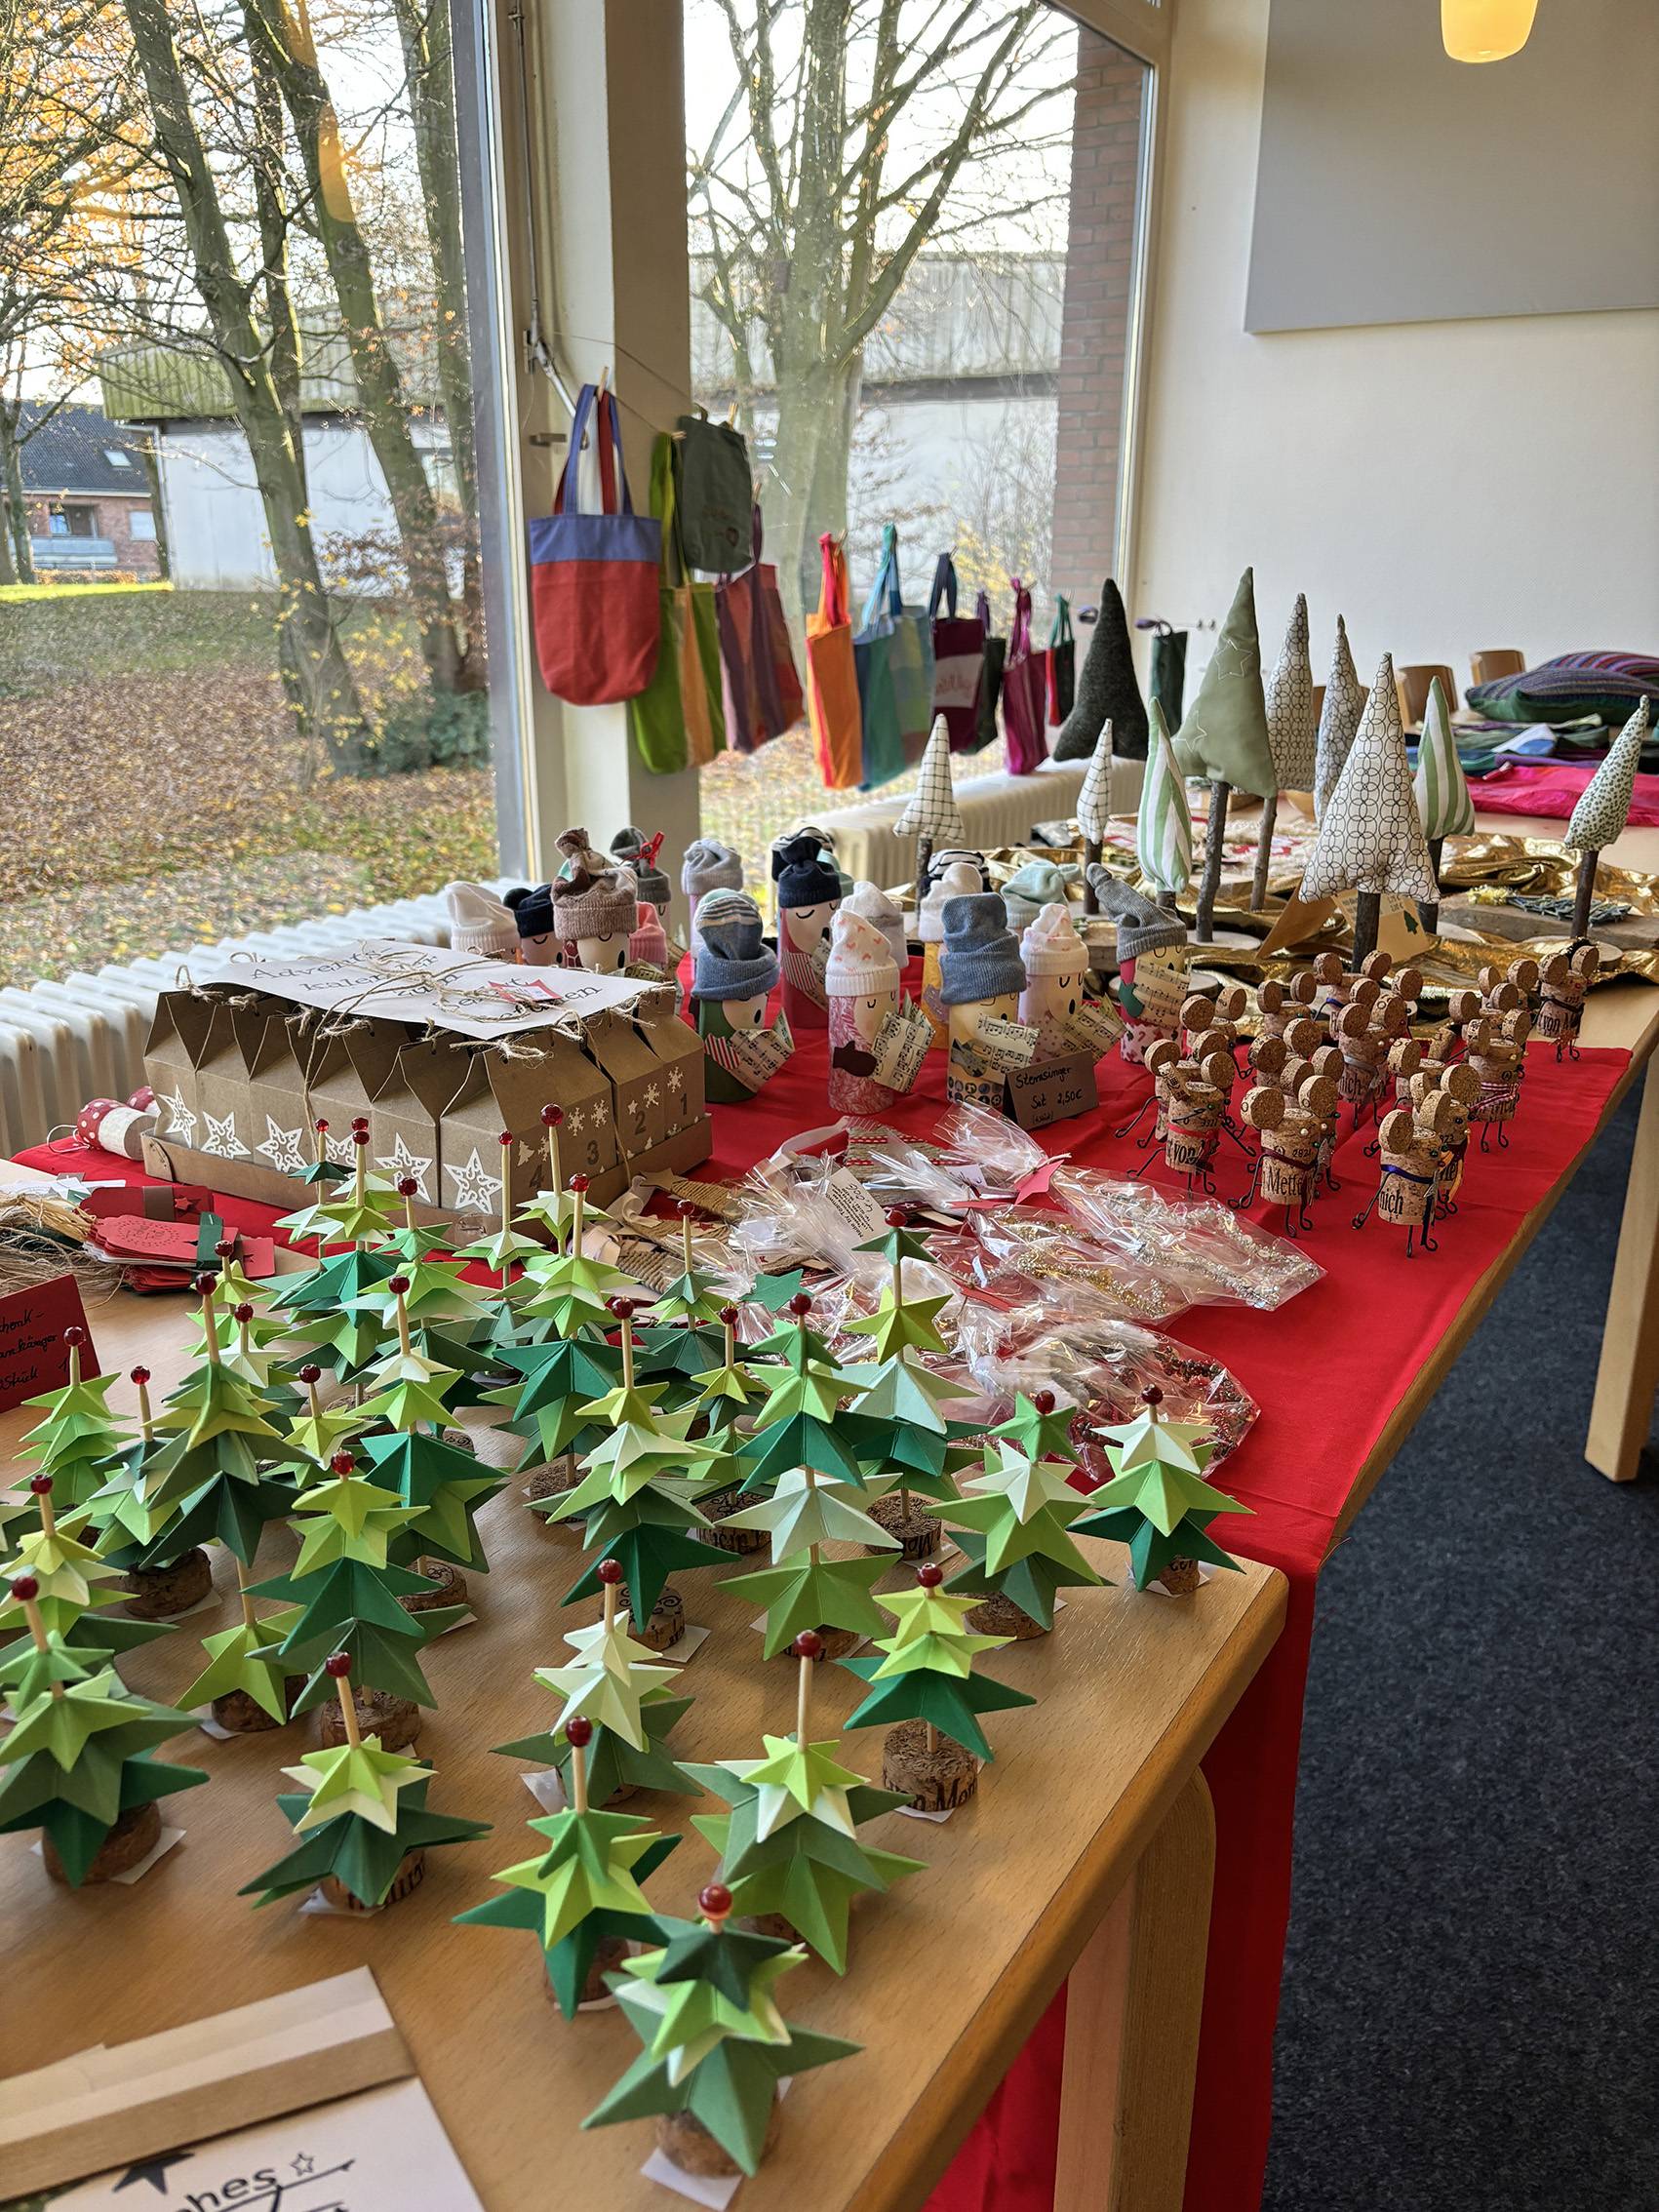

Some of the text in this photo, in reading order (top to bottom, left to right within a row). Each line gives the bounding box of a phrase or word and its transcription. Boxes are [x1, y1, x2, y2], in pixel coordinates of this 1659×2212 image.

[298, 955, 439, 992] kalener
[680, 1093, 688, 1115] 1
[635, 1110, 648, 1135] 2
[586, 1139, 601, 1165] 3
